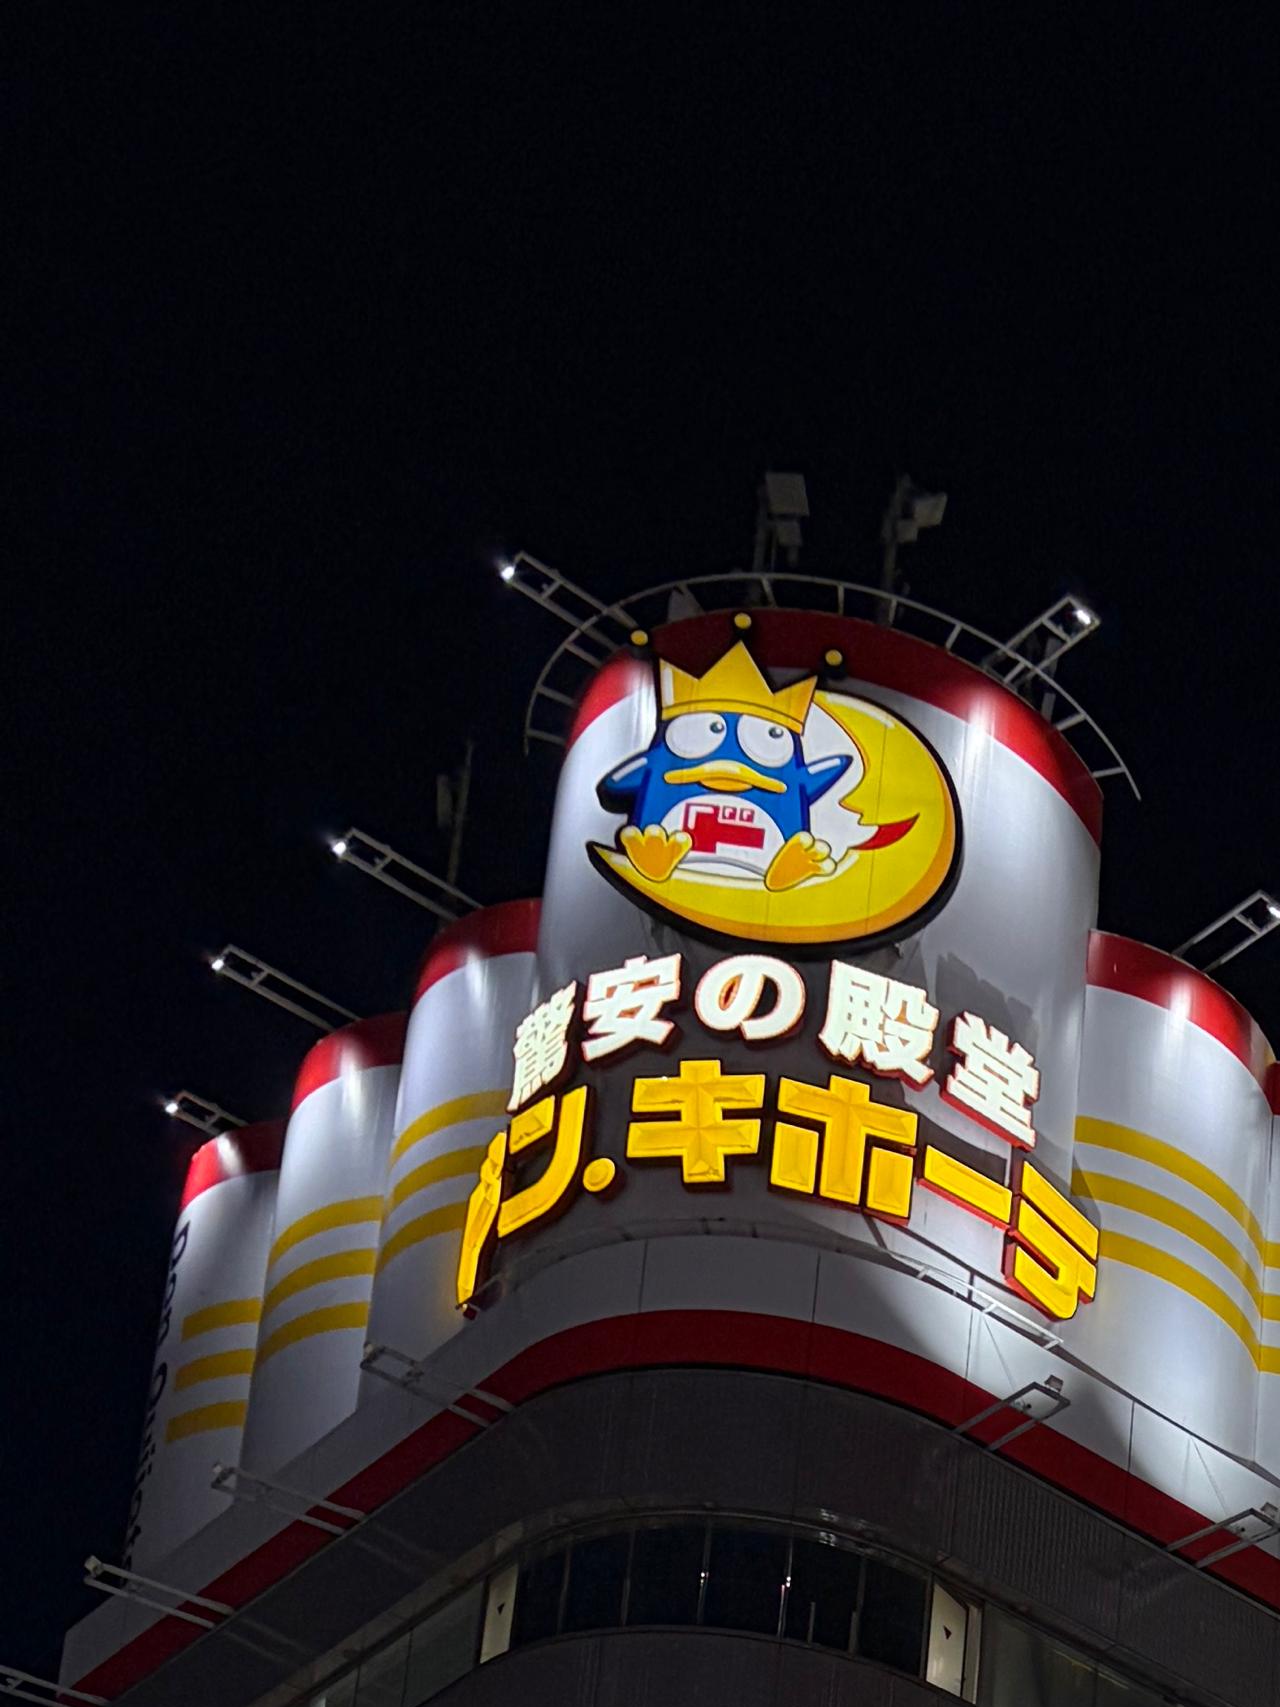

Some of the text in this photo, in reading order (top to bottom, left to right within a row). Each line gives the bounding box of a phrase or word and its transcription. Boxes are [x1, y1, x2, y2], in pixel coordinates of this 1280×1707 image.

[507, 953, 1040, 1152] 驚安の殿堂
